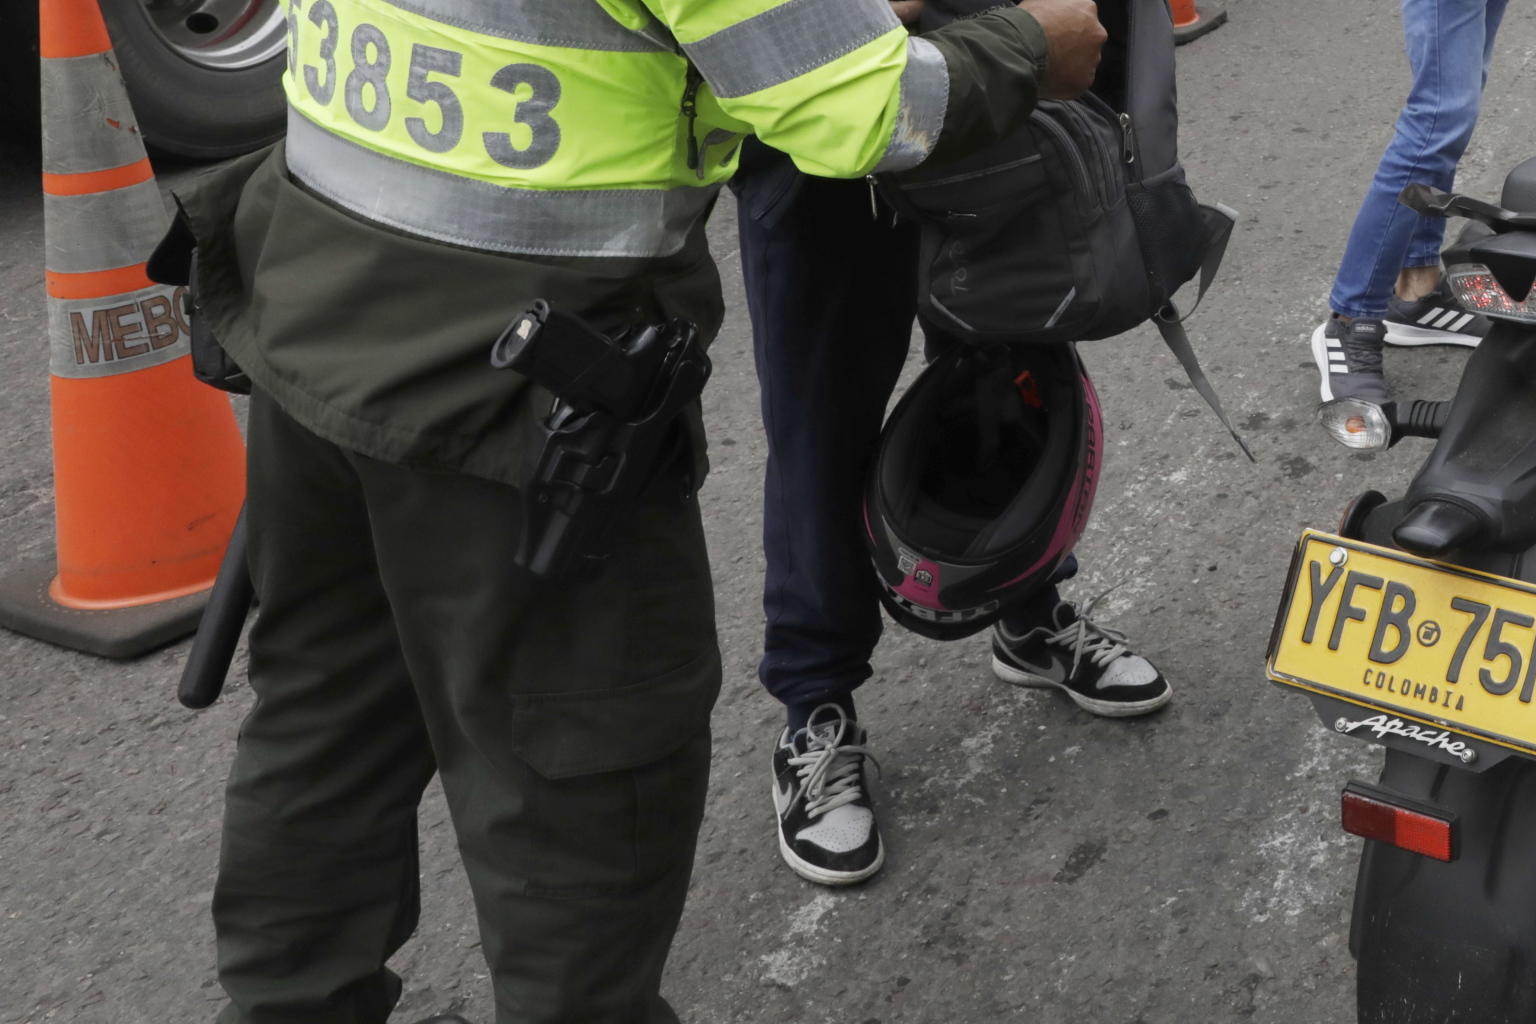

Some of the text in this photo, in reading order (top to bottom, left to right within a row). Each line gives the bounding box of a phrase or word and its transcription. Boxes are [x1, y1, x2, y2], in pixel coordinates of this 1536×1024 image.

[1302, 560, 1416, 664] YFB
[1363, 669, 1465, 711] COLOMBIA
[1345, 714, 1467, 757] Apache
